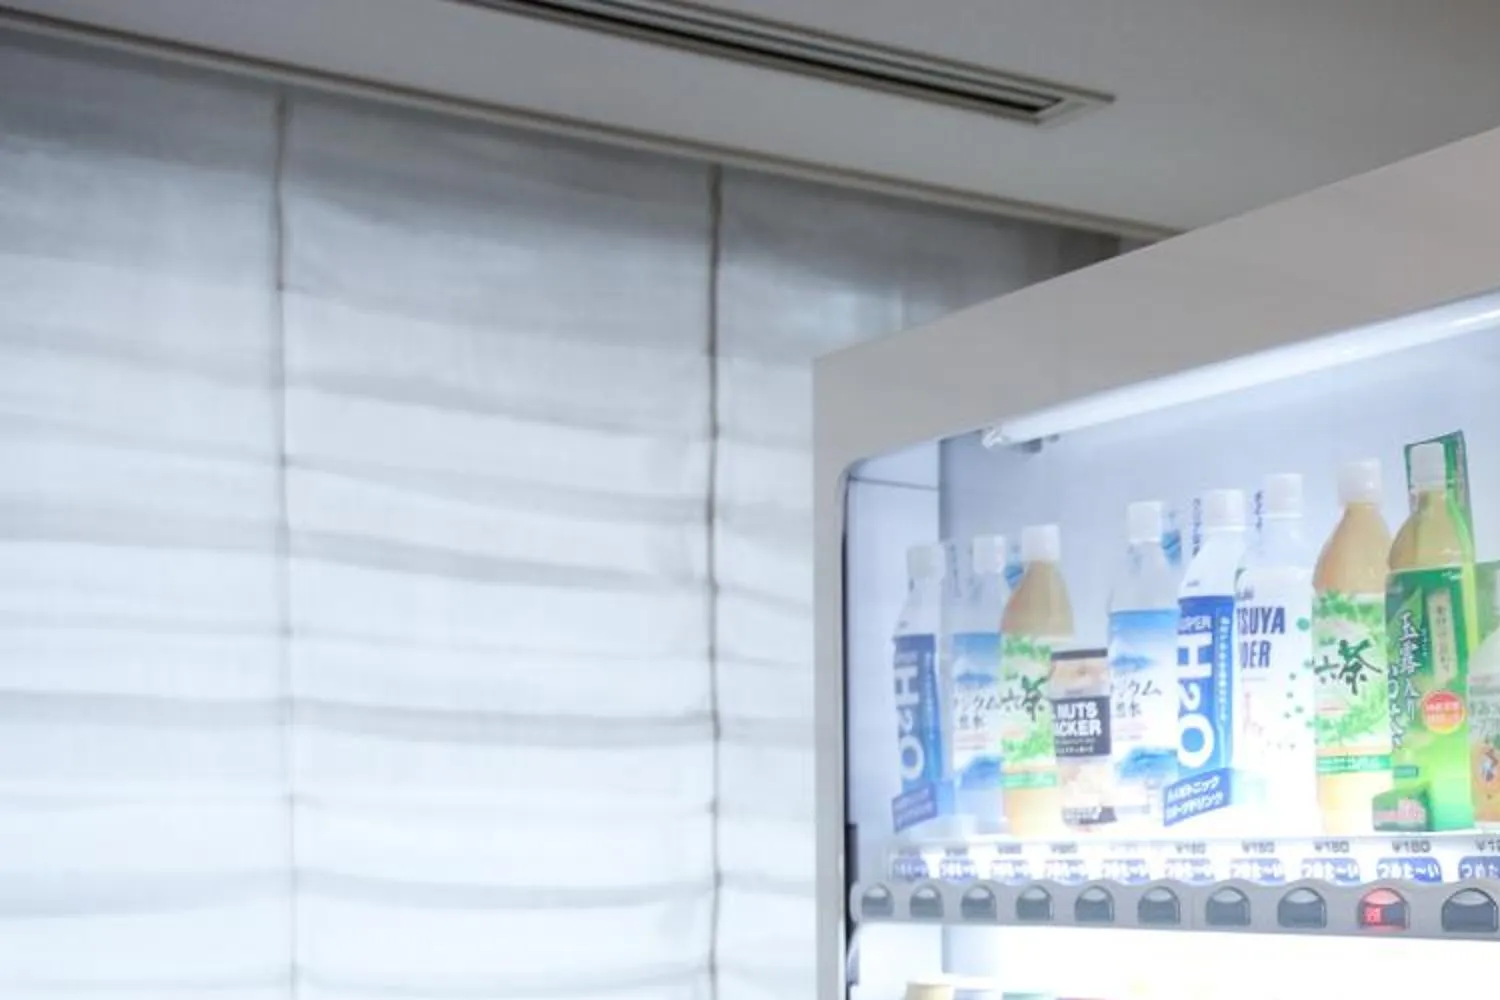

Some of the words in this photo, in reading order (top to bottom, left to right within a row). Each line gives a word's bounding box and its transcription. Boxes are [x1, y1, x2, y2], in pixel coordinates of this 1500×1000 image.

[1311, 639, 1383, 696] 六茶
[1001, 675, 1050, 722] 六茶
[1054, 702, 1099, 720] NUTS
[1177, 632, 1214, 769] H2O
